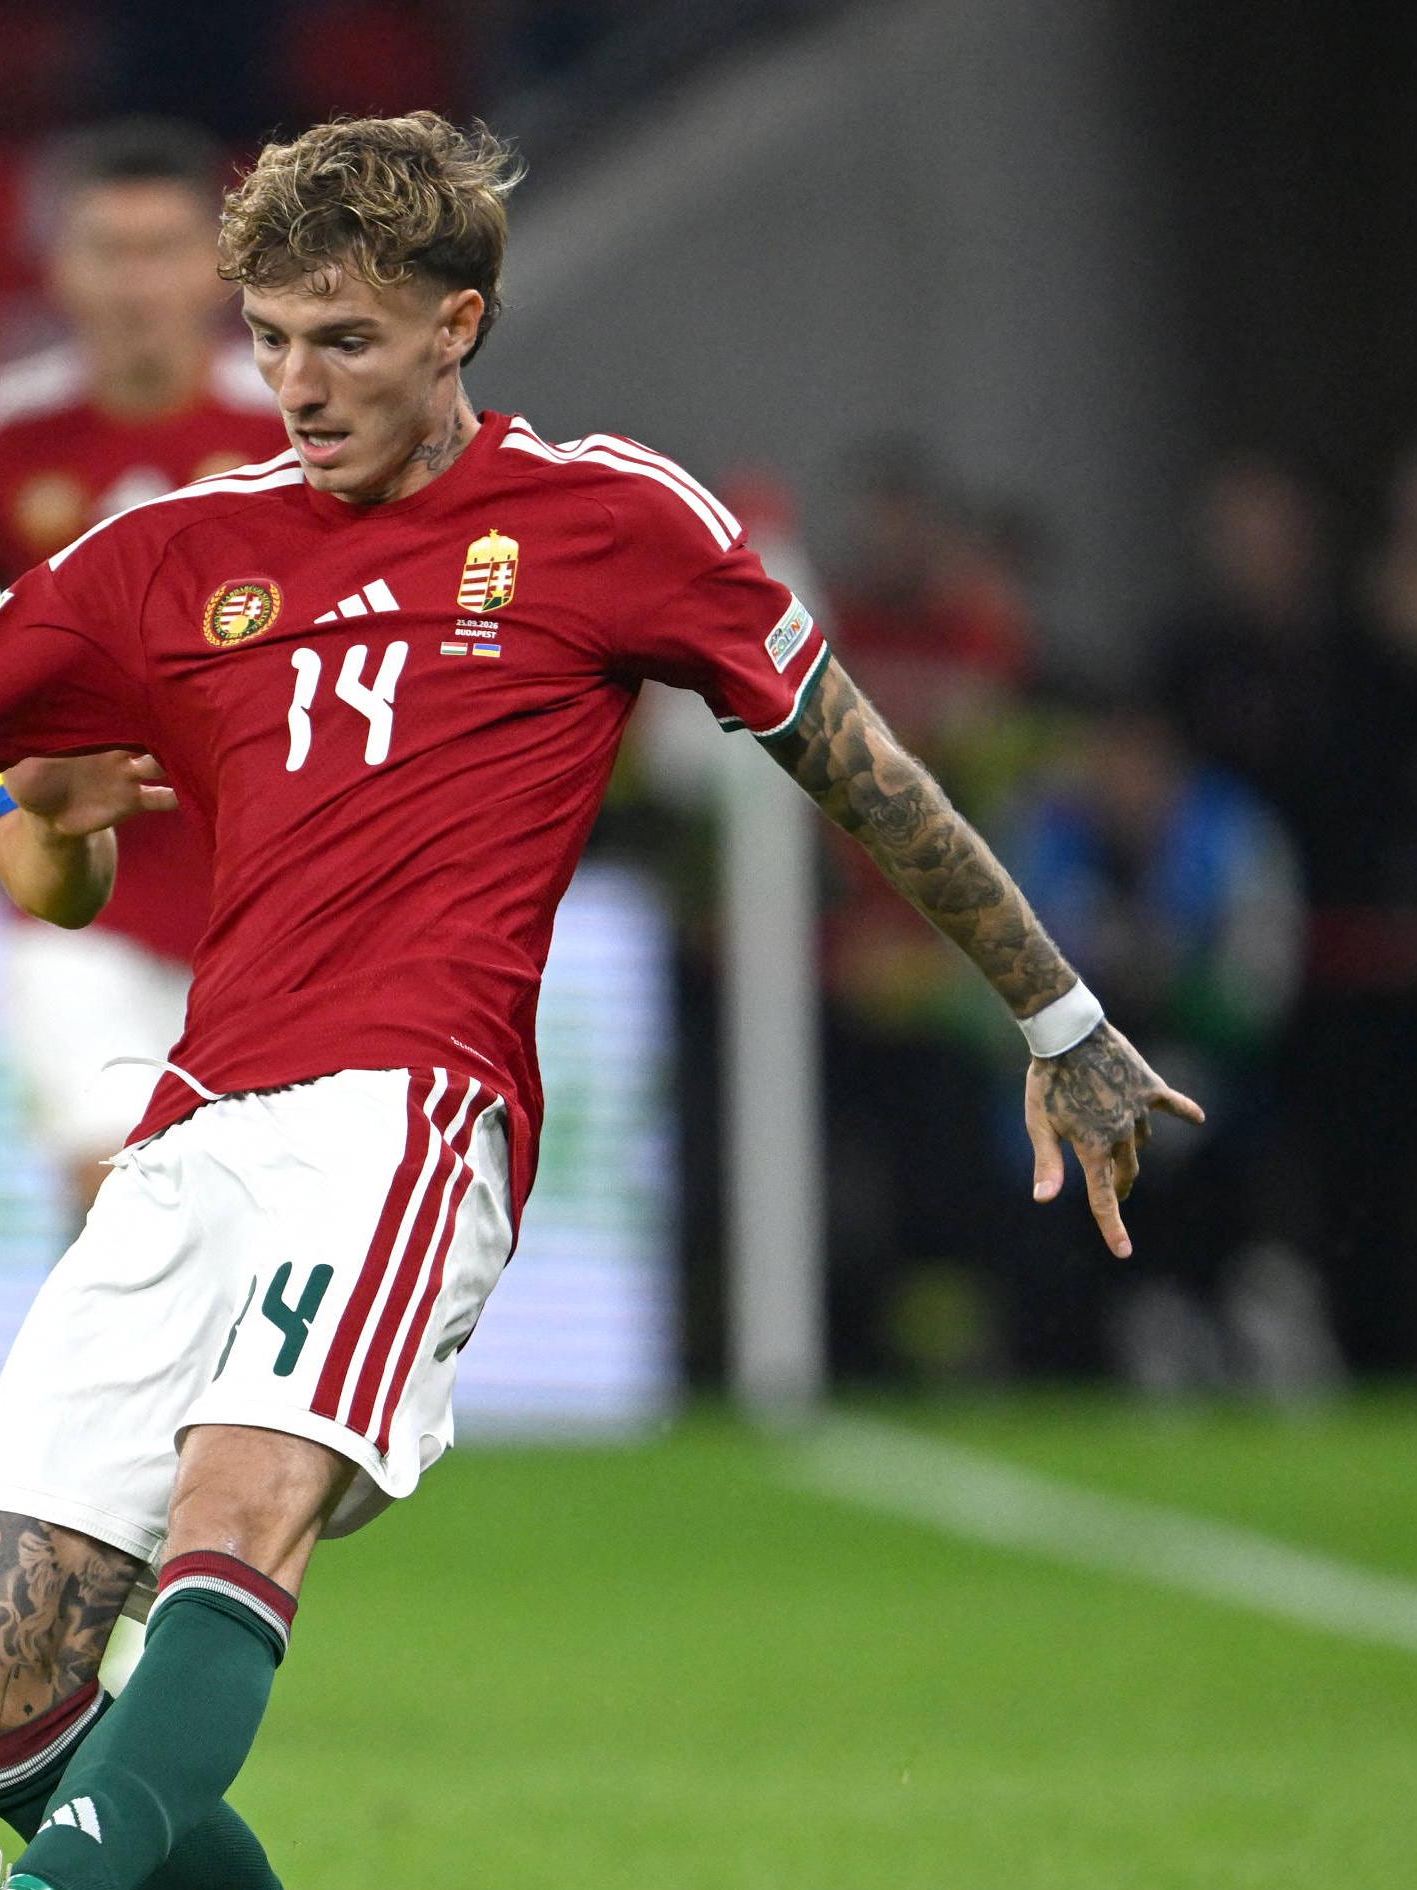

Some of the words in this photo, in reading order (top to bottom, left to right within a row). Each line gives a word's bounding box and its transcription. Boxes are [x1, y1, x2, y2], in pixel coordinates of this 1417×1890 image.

[455, 629, 497, 638] BUDAPEST
[286, 641, 410, 772] 14
[212, 1261, 334, 1383] 4
